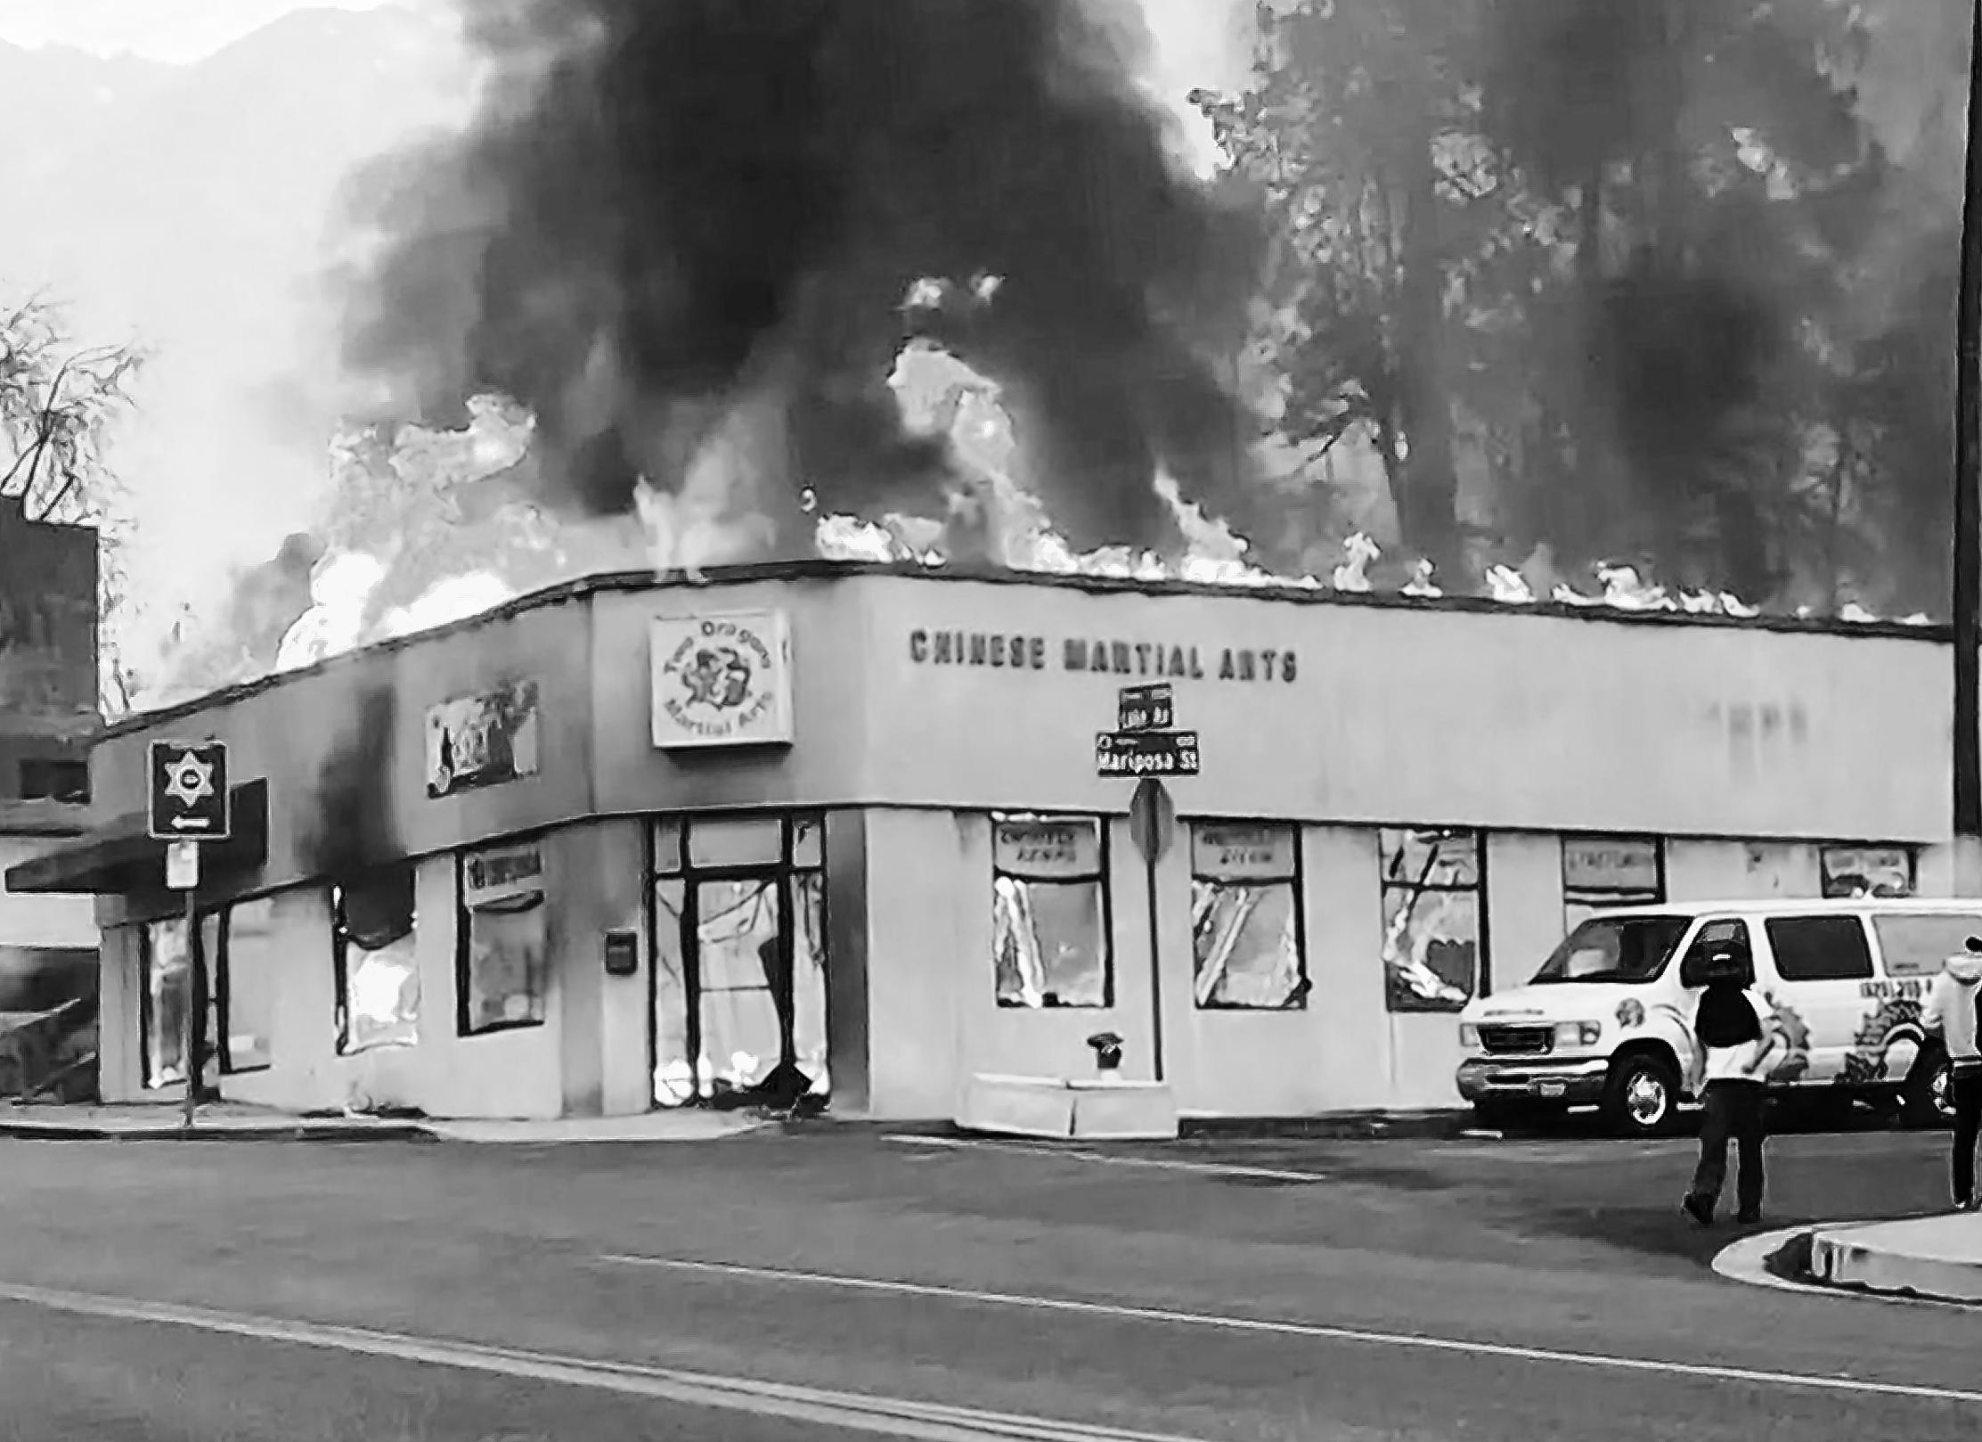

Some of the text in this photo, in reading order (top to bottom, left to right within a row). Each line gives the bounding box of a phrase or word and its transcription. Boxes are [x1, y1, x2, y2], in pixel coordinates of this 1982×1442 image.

[910, 629, 1297, 682] CHINESE MARTIAL ARTS
[1098, 749, 1174, 774] Mariposa
